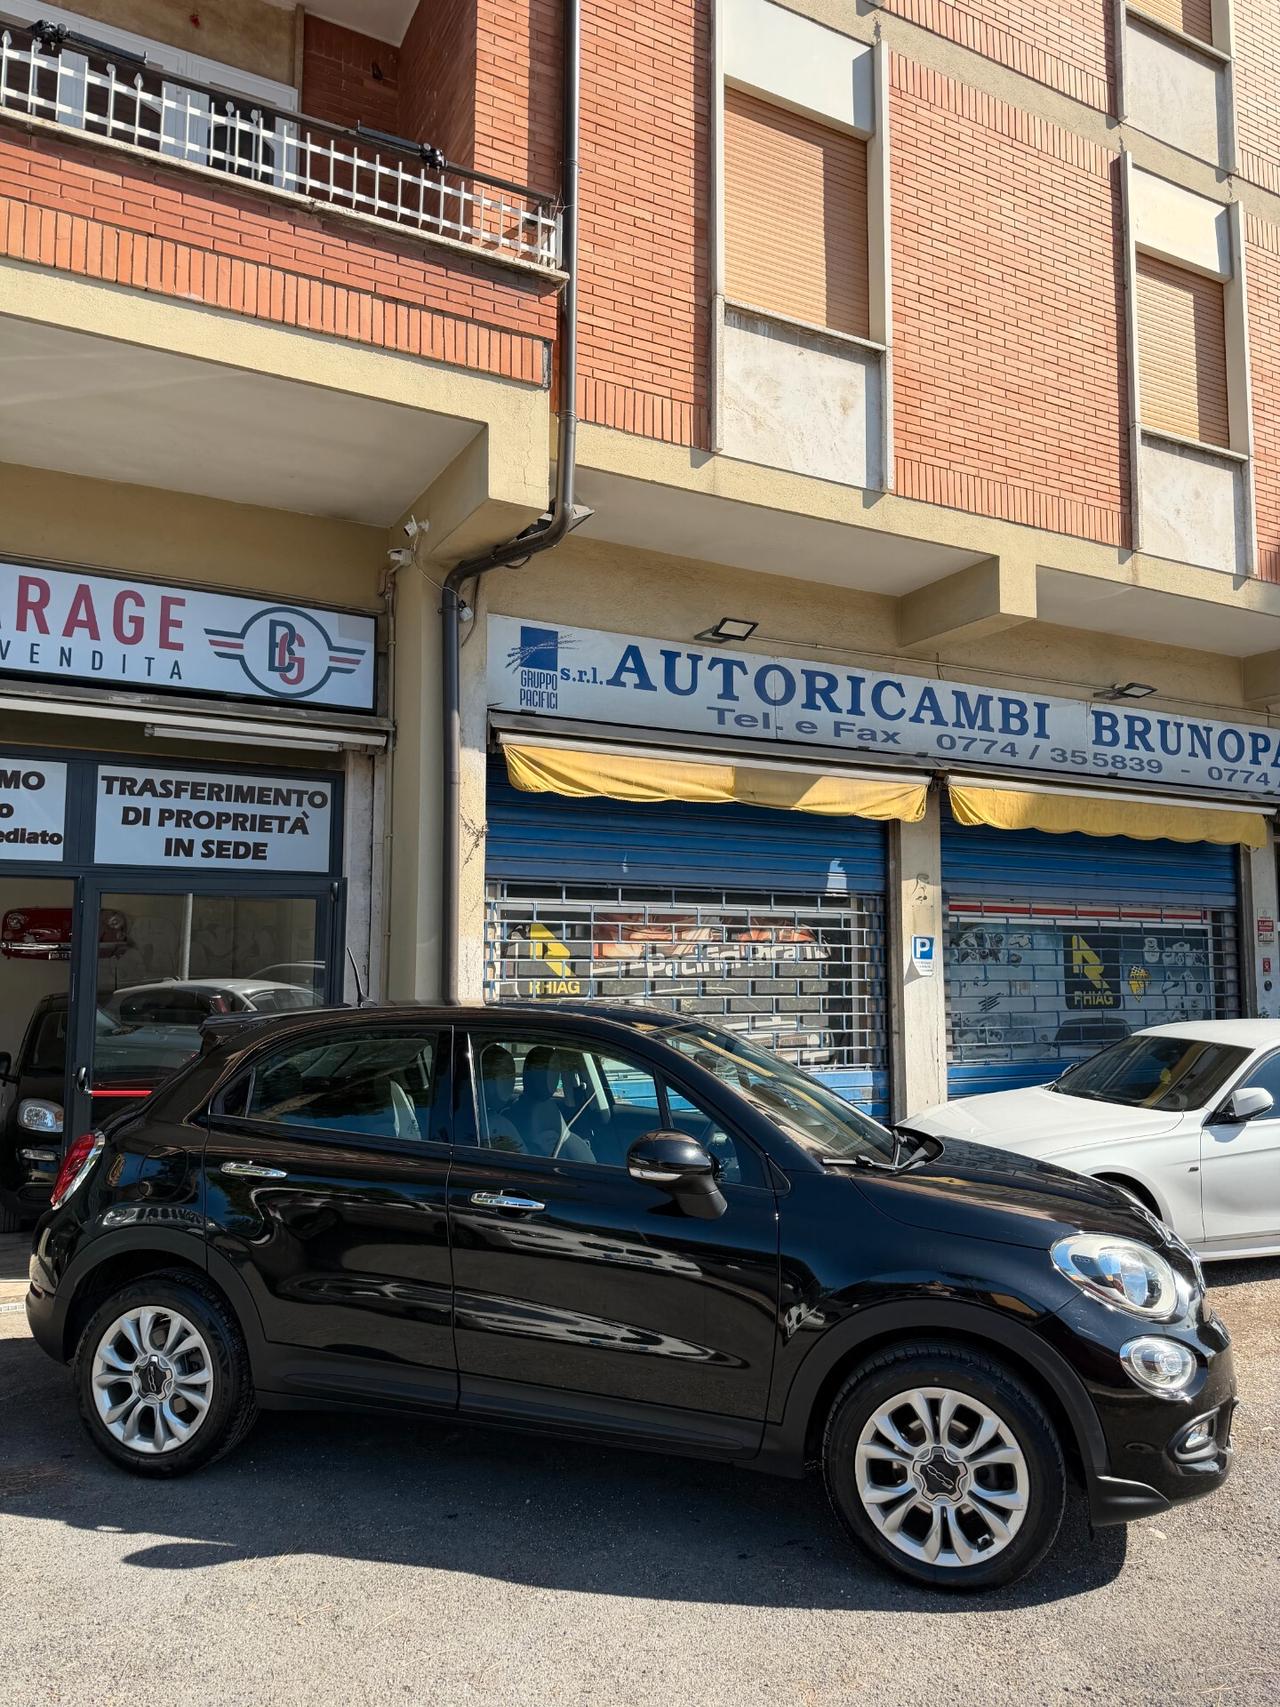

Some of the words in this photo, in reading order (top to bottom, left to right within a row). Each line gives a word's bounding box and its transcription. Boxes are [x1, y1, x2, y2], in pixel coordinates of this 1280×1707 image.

[0, 638, 182, 680] VENDITA
[520, 669, 558, 691] GRUPPO
[560, 667, 604, 685] s.r.l.
[606, 644, 1051, 740] AUTORICAMBI
[519, 688, 558, 710] PACIFICI
[706, 706, 784, 731] Tel.
[795, 720, 818, 735] e
[833, 721, 902, 745] Fax
[1050, 748, 1163, 774] 355839
[1207, 766, 1271, 786] 0774
[101, 775, 329, 809] TRASFERIMENTO
[121, 806, 151, 826] DI
[158, 808, 310, 835] PROPRIETÀ
[164, 838, 195, 857] IN
[200, 839, 268, 860] SEDE
